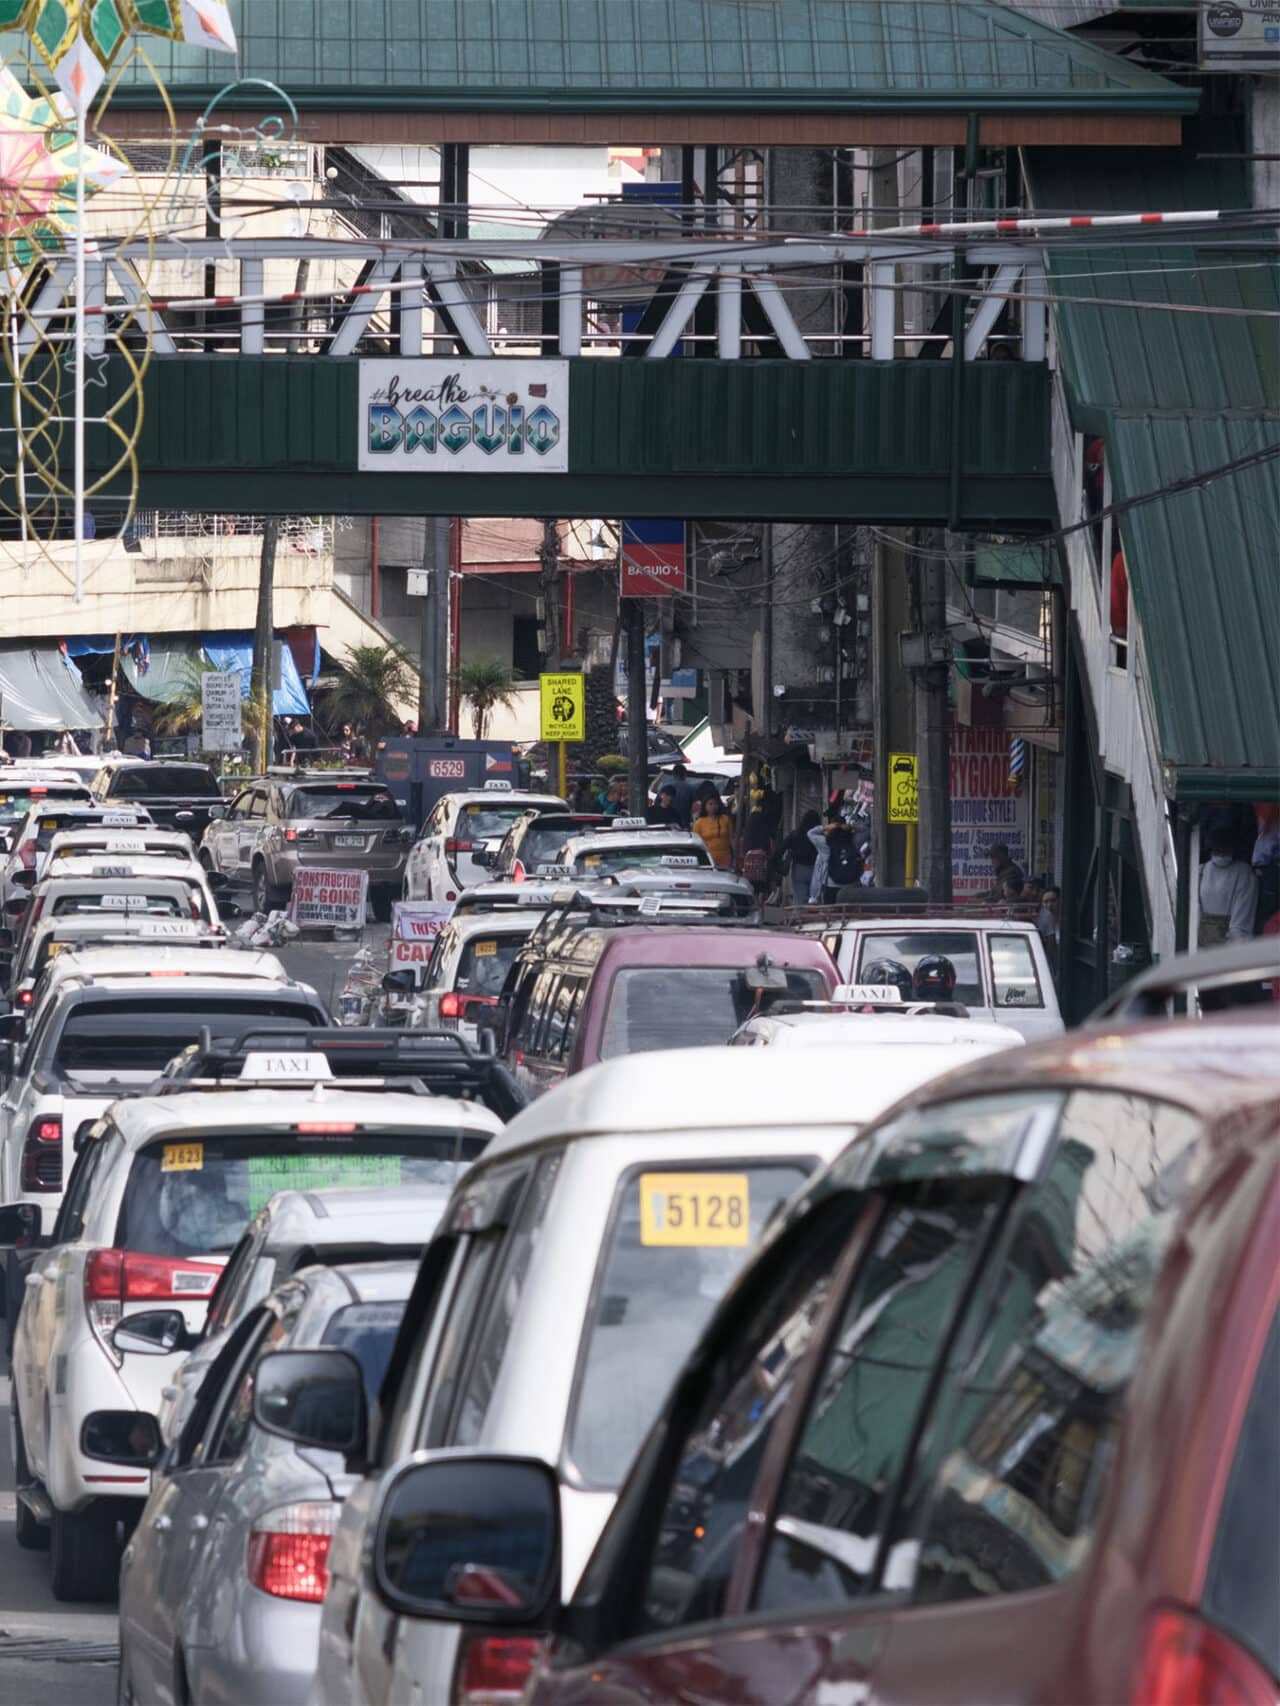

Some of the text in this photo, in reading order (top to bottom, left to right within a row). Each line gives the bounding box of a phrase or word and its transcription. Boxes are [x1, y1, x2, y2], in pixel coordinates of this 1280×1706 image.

[368, 403, 560, 456] BAGUIO
[547, 678, 577, 686] SHARED
[552, 687, 572, 695] LANE
[545, 866, 570, 874] TAXI
[296, 887, 360, 905] ON-GOING
[153, 925, 184, 934] TAXI
[410, 920, 437, 936] THIS
[849, 989, 887, 999] TAXI
[264, 1058, 310, 1072] TAXI
[667, 1194, 743, 1229] 5128
